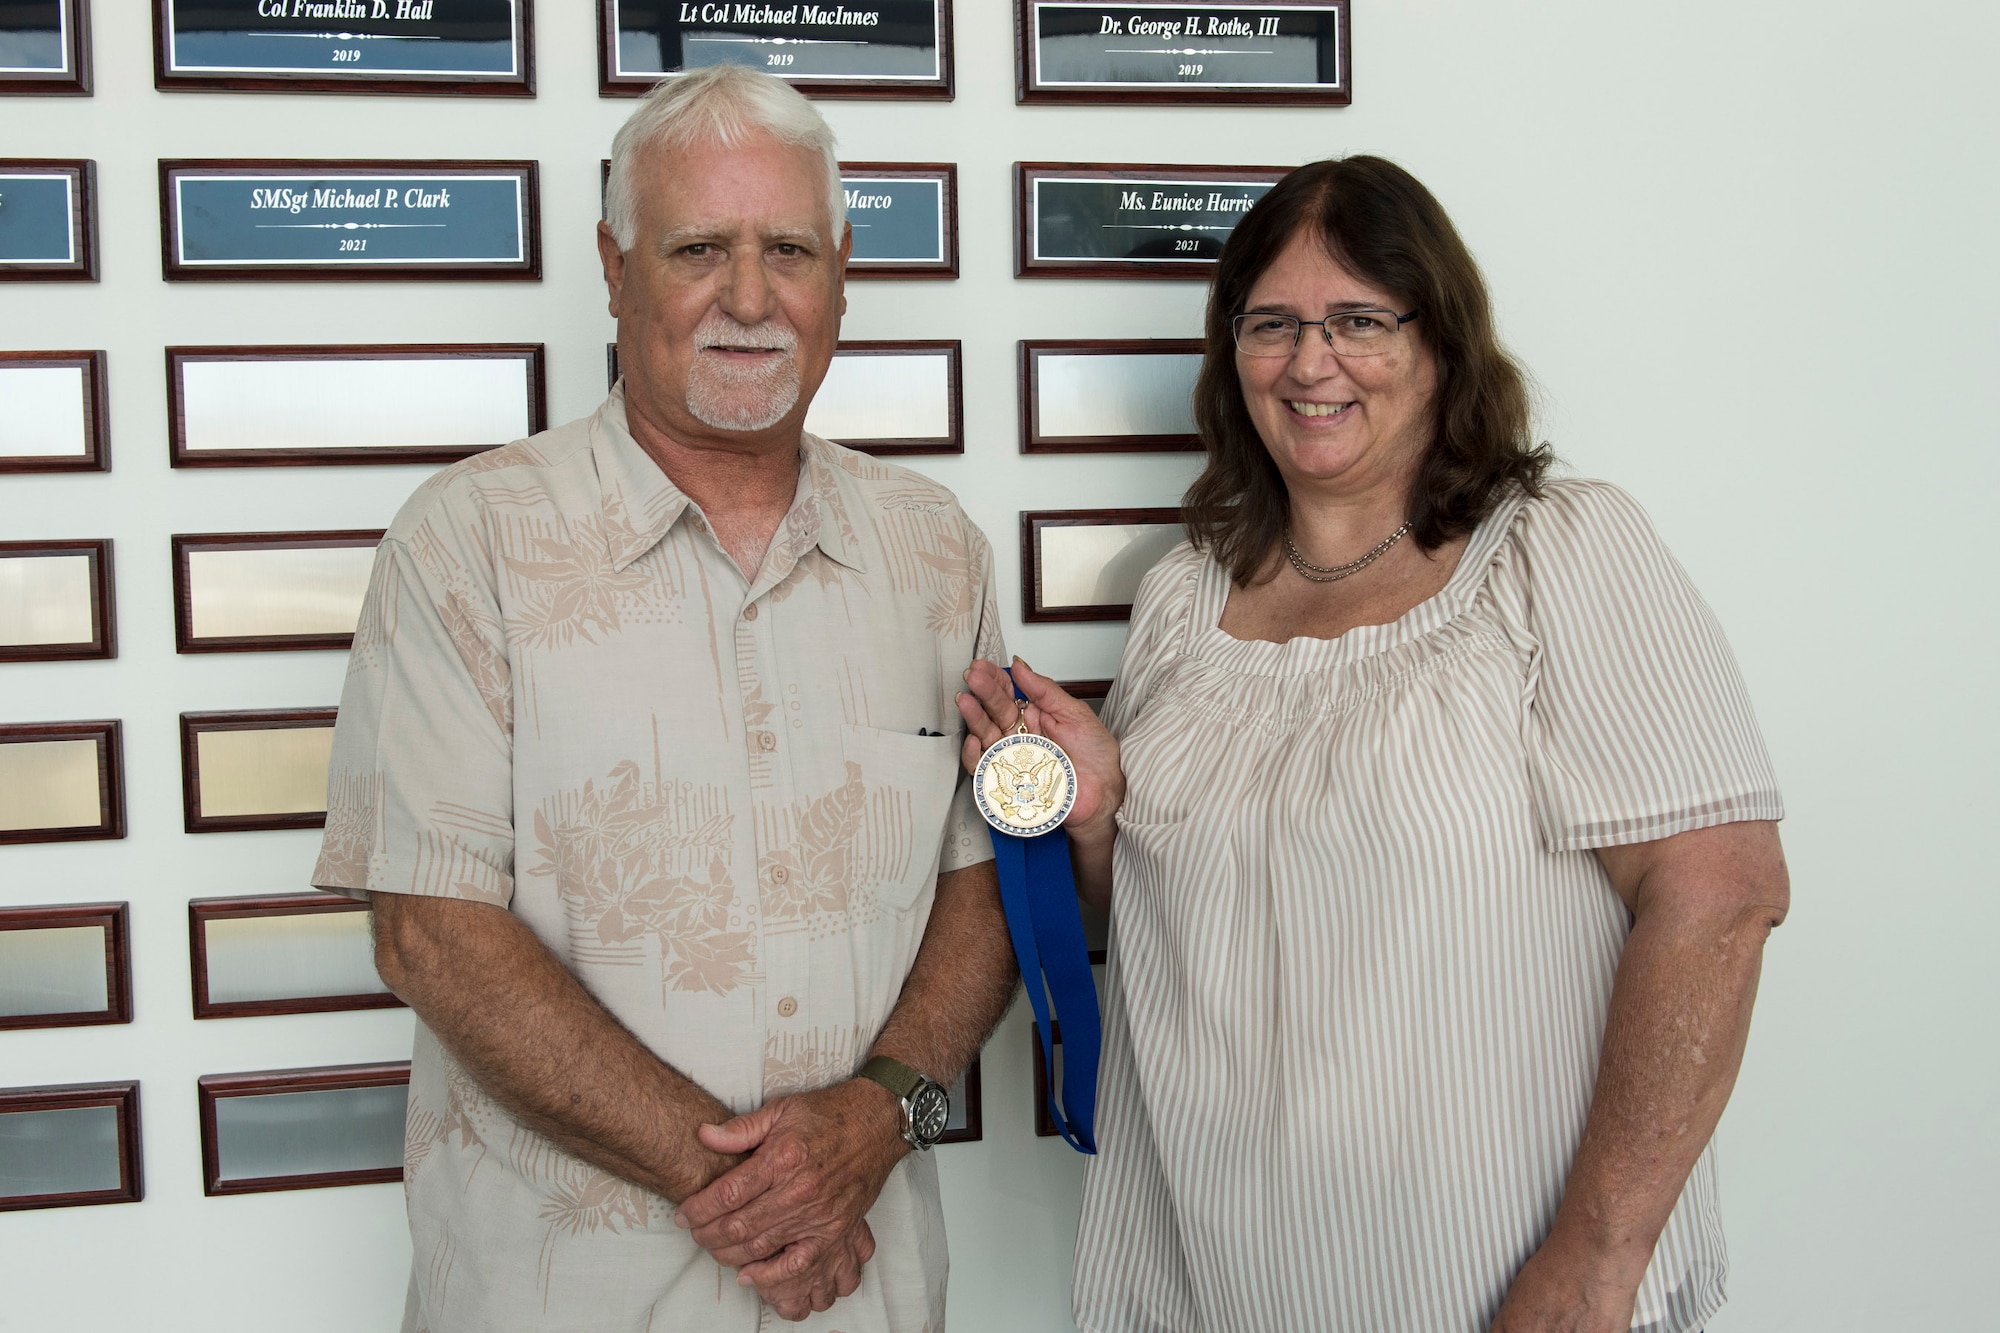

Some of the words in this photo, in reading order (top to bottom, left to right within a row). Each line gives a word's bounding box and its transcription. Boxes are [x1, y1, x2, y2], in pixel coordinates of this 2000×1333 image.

[258, 0, 288, 18] Col
[291, 0, 367, 19] Franklin
[370, 0, 390, 20] D.
[394, 0, 434, 20] Hall
[678, 3, 698, 23] Lt
[701, 3, 730, 23] Col
[732, 4, 798, 25] Michael
[800, 5, 879, 26] MacInnes
[1099, 15, 1123, 35] Dr.
[1127, 15, 1182, 40] George
[1183, 16, 1203, 36] H.
[1206, 16, 1254, 39] Rothe,
[1257, 17, 1281, 36] III
[331, 49, 361, 62] 2019
[766, 54, 795, 66] 2019
[1177, 64, 1204, 76] 2019
[250, 188, 309, 214] SMSgt
[311, 188, 381, 209] Michael
[383, 188, 399, 209] P.
[404, 188, 451, 209] Clark
[843, 189, 892, 209] Marco
[1118, 191, 1147, 211] Ms.
[1150, 191, 1203, 212] Eunice
[1205, 192, 1255, 213] Harris
[339, 239, 367, 252] 2021
[1174, 239, 1200, 251] 2021
[977, 748, 1002, 776] WALL
[1001, 738, 1016, 748] OF
[1020, 736, 1058, 754] HONOR
[1059, 755, 1075, 813] INDUCTEE
